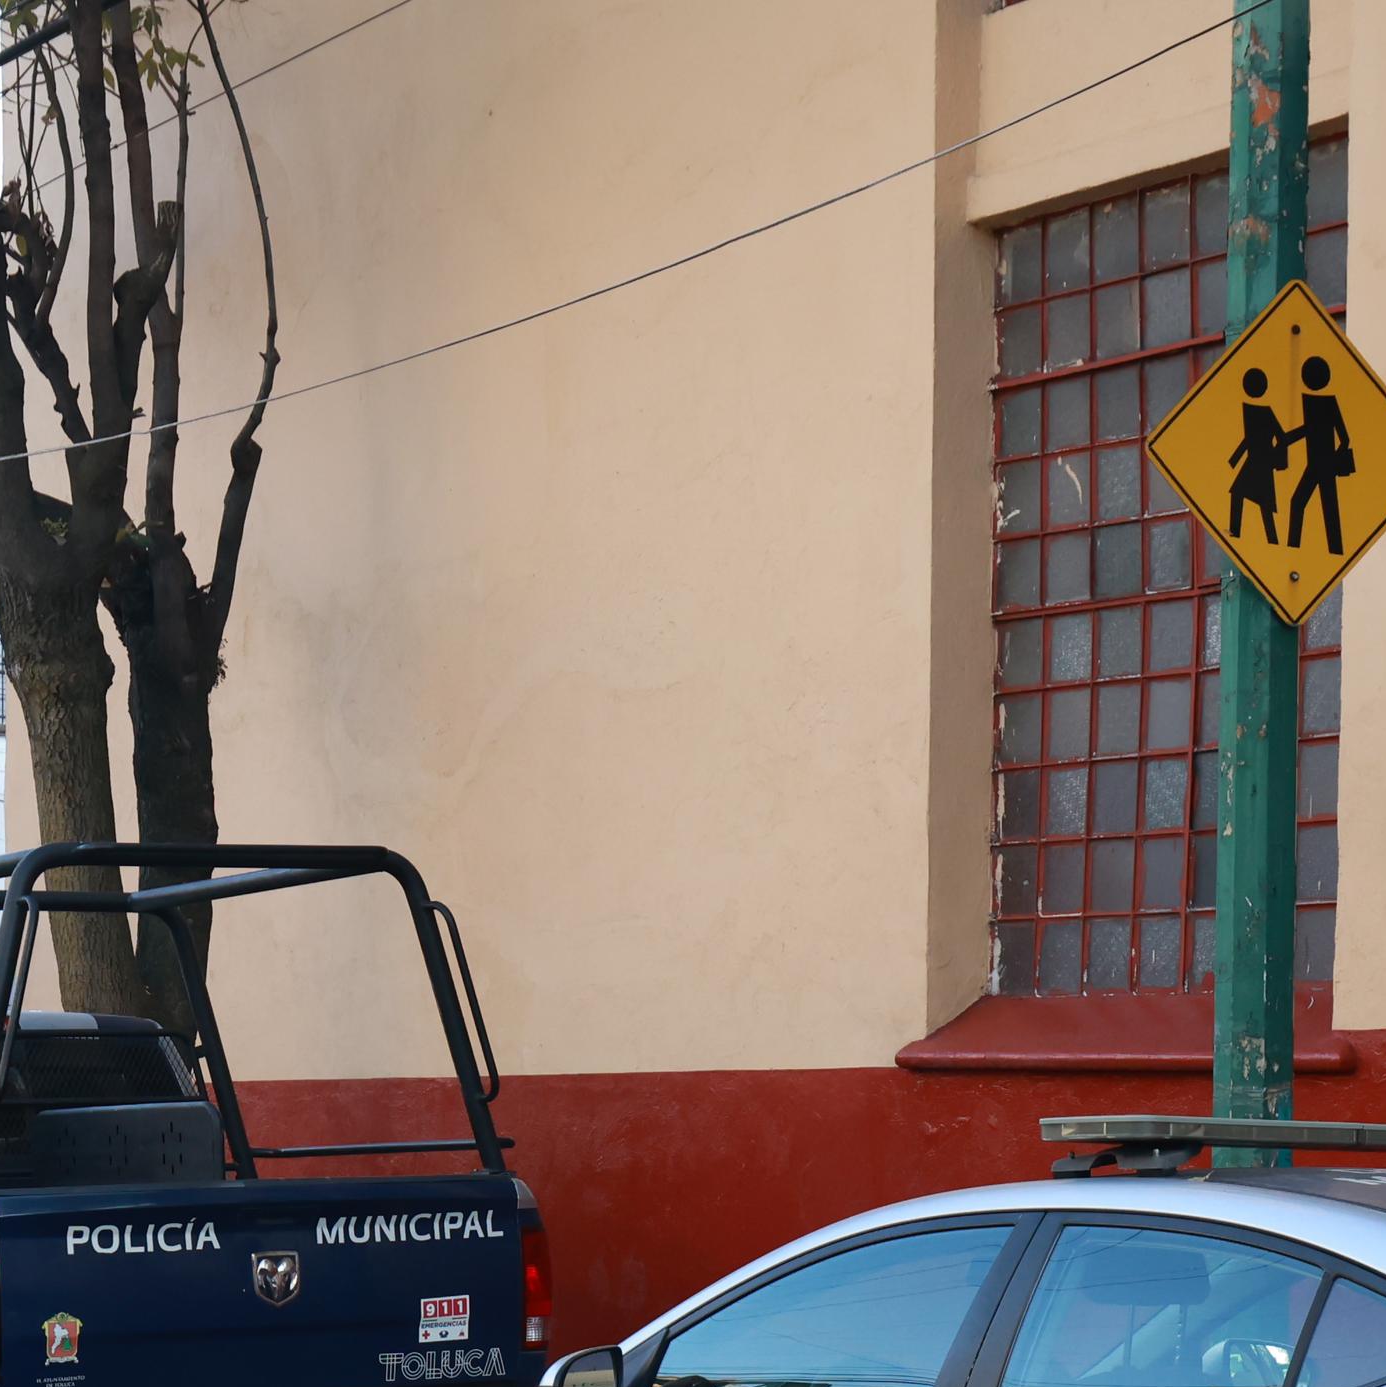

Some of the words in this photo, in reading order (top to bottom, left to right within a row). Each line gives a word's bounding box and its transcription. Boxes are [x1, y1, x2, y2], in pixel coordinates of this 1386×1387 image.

[67, 1217, 221, 1255] POLICÍA
[316, 1210, 504, 1245] MUNICIPAL
[426, 1300, 463, 1316] 911
[421, 1320, 466, 1329] EMERGENCIAS
[379, 1347, 506, 1382] TOLUCA
